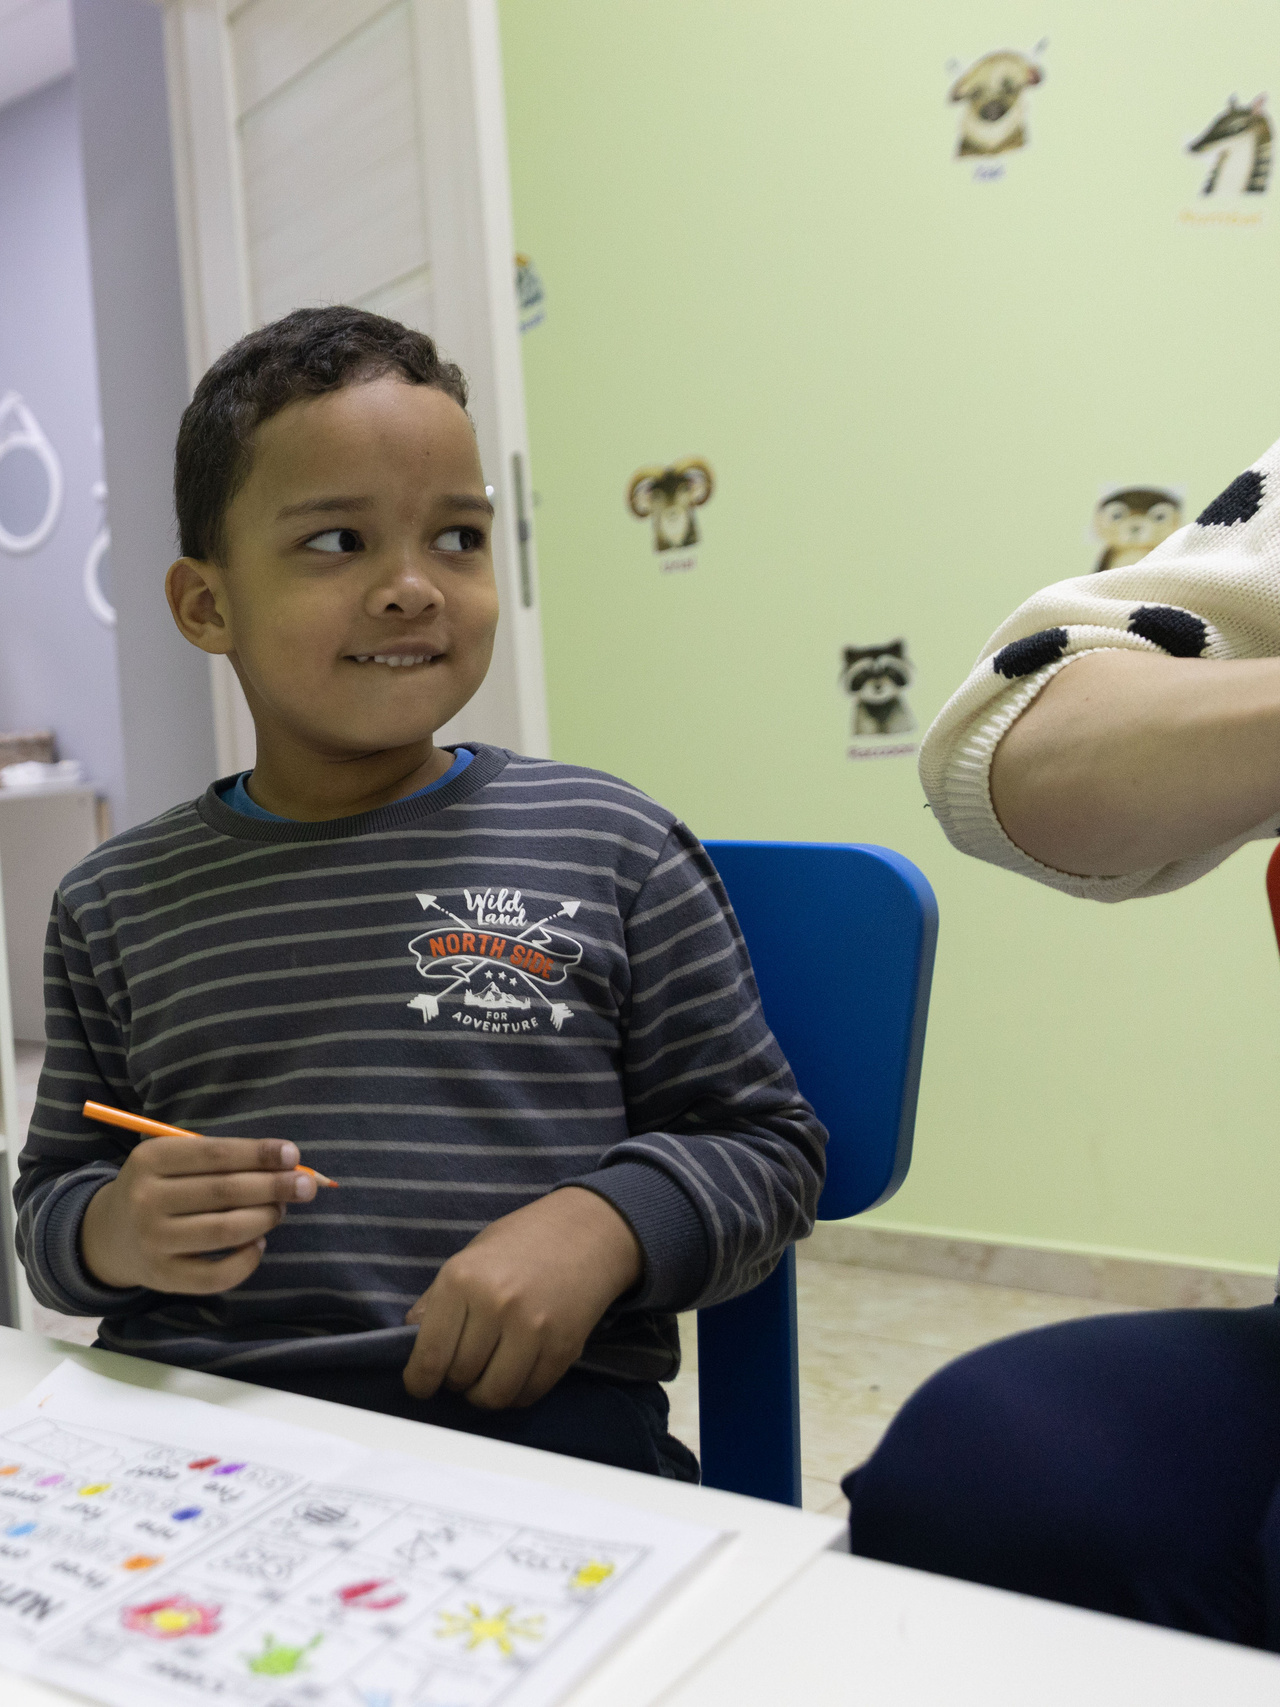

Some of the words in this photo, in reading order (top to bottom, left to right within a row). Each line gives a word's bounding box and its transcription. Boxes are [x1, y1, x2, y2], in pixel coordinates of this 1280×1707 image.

[463, 888, 523, 912] Wild
[477, 908, 527, 926] Land
[429, 932, 506, 958] NORTH
[510, 945, 554, 979] SIDE
[452, 1011, 538, 1033] ADVENTURE
[486, 1011, 508, 1020] FOR
